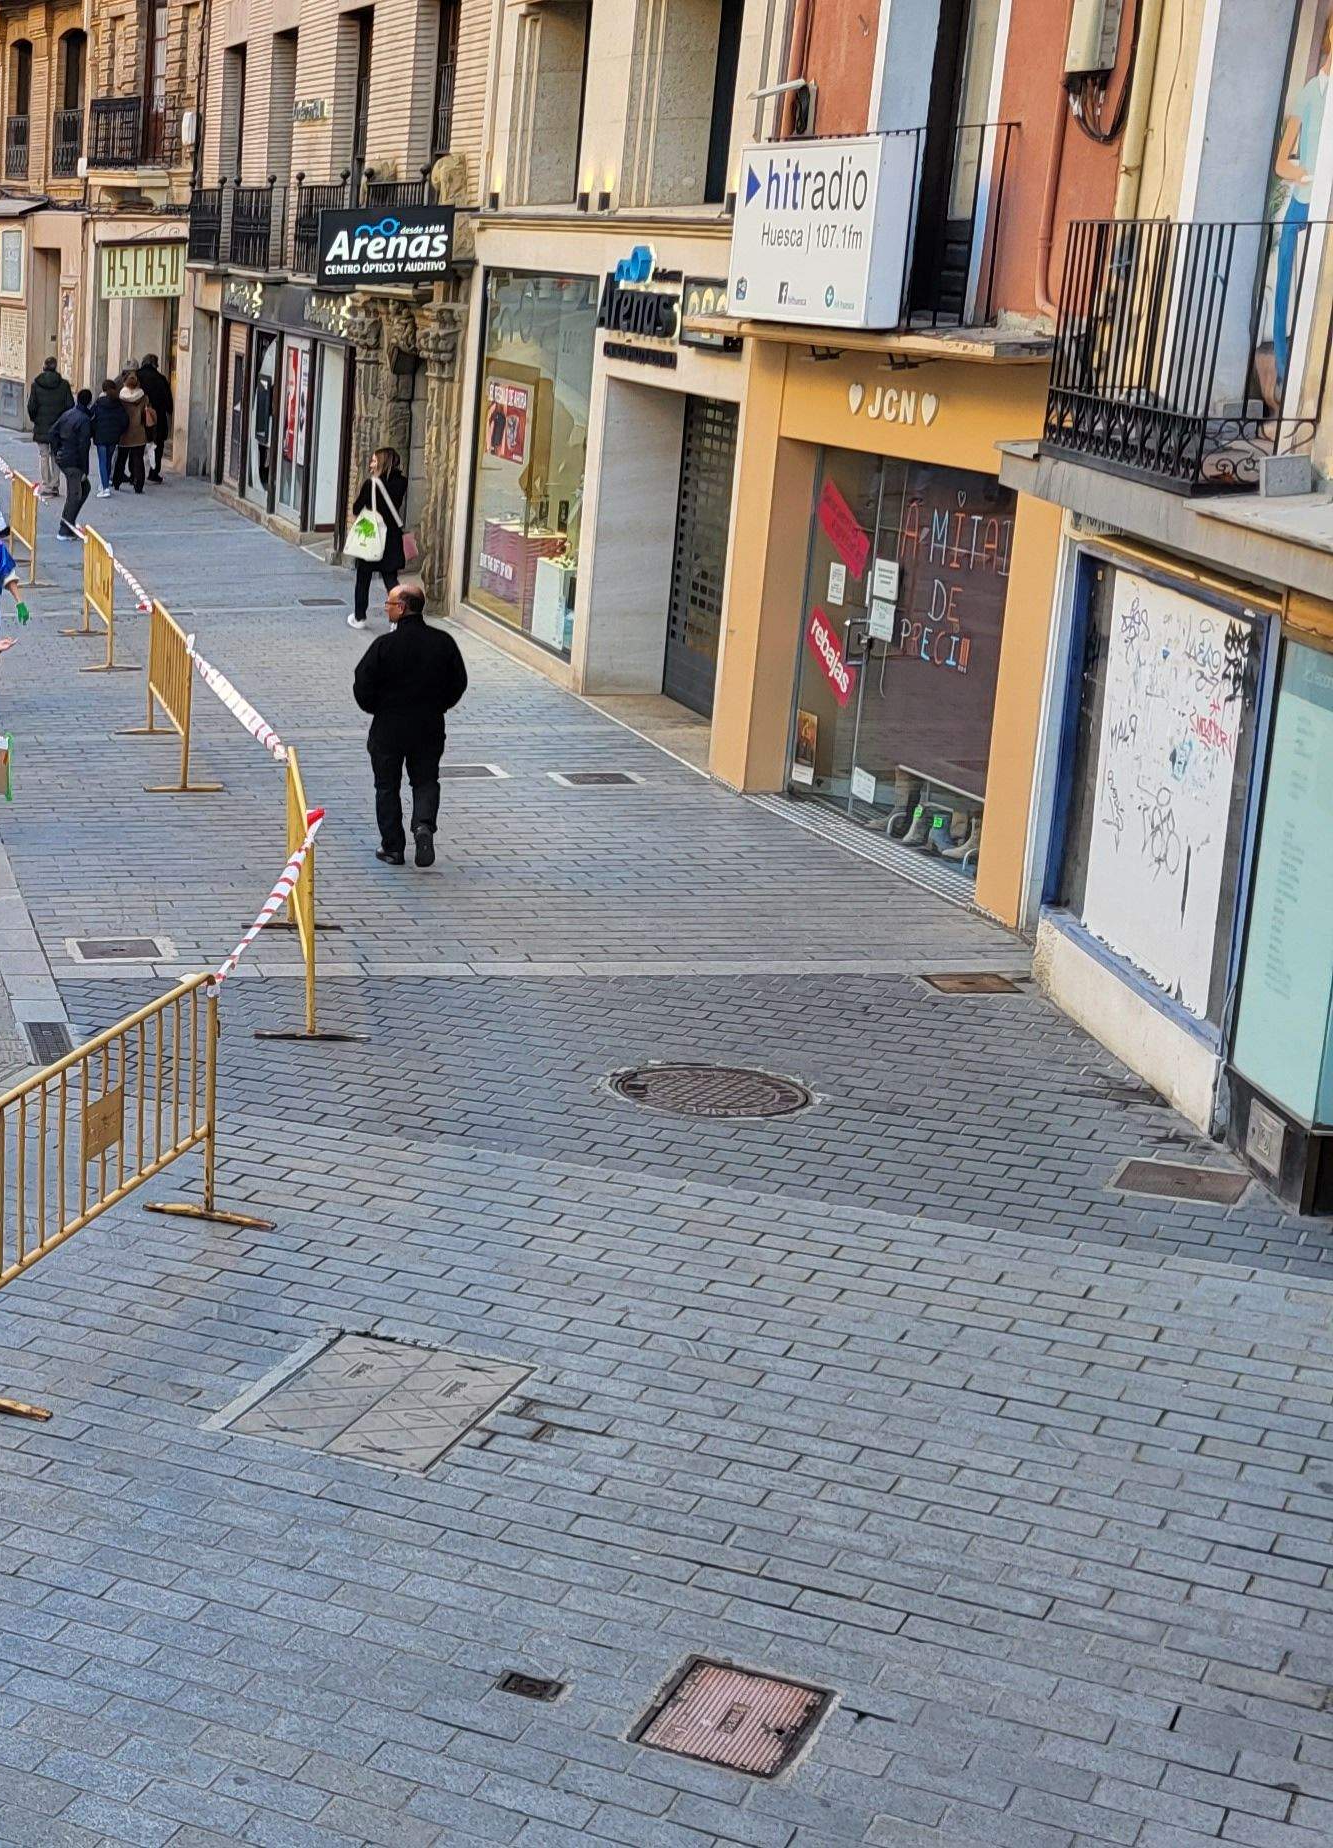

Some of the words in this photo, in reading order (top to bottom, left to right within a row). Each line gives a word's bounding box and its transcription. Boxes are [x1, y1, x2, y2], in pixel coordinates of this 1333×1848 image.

[765, 155, 868, 211] hitradio
[325, 230, 449, 262] Arenas
[400, 225, 424, 235] desde
[761, 222, 804, 248] Huesca
[816, 223, 863, 250] 107.1fm
[107, 246, 180, 288] ASCASO
[324, 264, 361, 275] CENTRO
[362, 261, 396, 274] ÓPTICO
[397, 262, 403, 273] Y
[404, 260, 447, 273] AUDITIVO
[596, 272, 681, 338] Arenas
[867, 386, 917, 425] JCN
[927, 578, 964, 623] DE
[810, 617, 851, 693] rebajas
